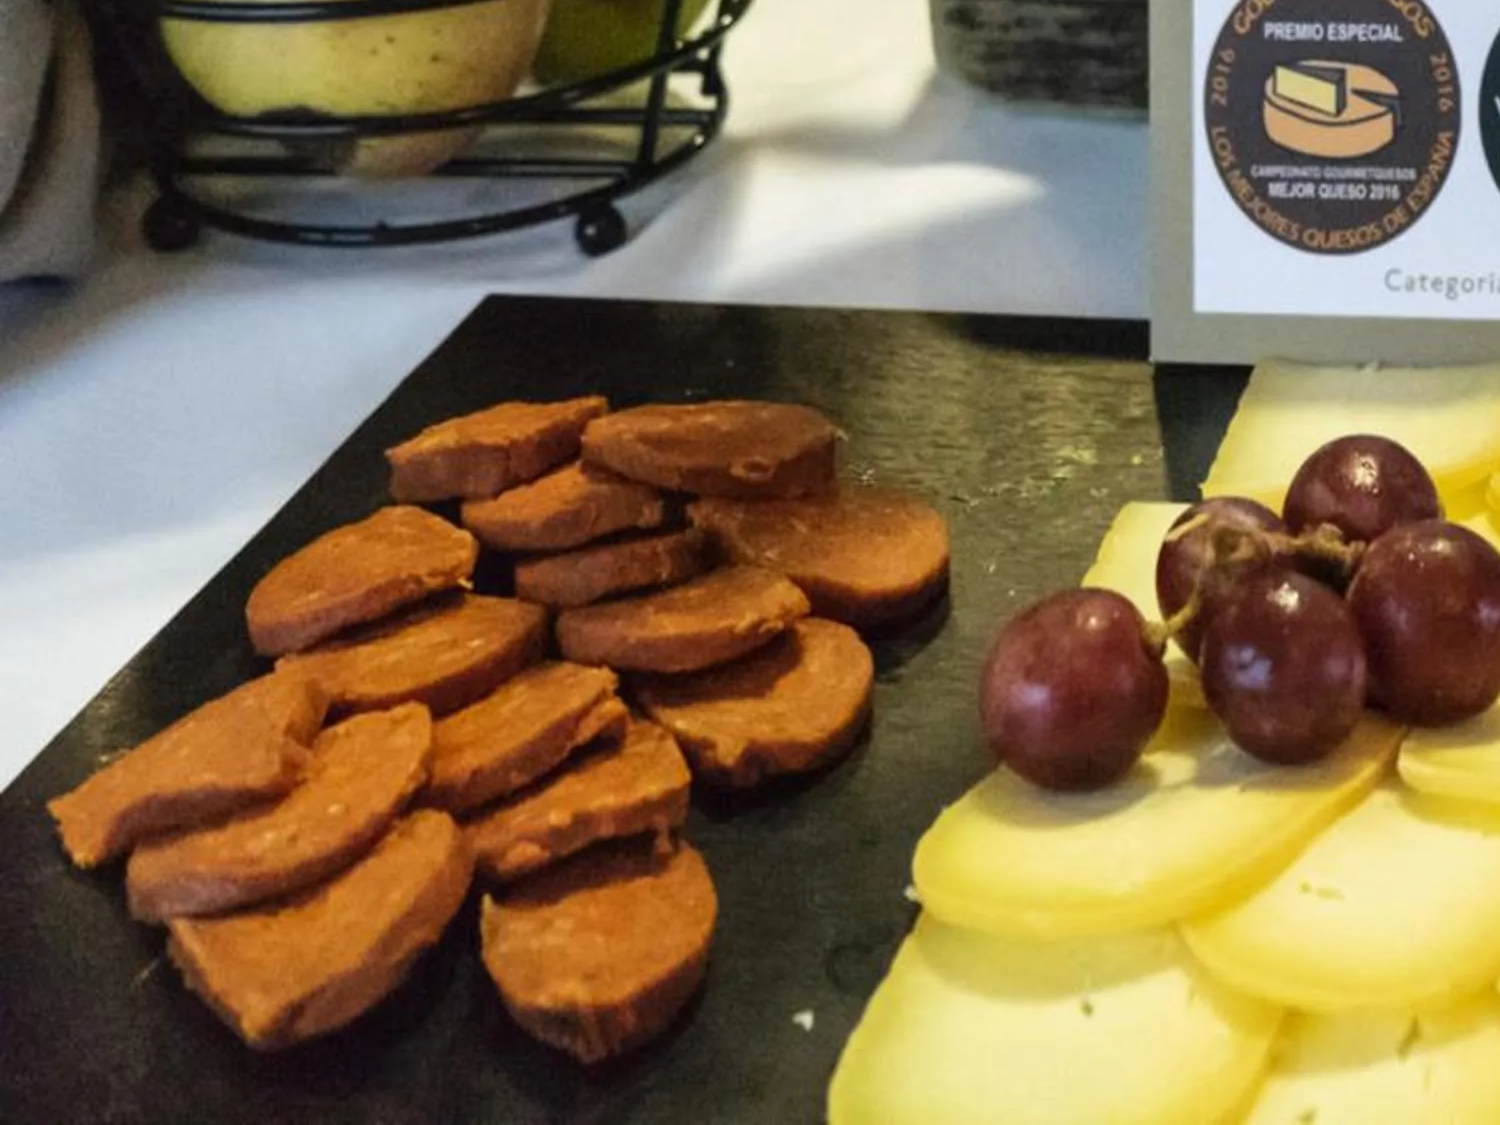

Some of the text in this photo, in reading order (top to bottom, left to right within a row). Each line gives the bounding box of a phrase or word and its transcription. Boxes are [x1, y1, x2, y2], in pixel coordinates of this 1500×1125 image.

[1264, 22, 1403, 42] PREMIO ESPECIAL
[1211, 48, 1235, 106] 2016
[1430, 52, 1454, 113] 2016
[1211, 126, 1238, 169] LOS
[1229, 169, 1299, 241] MEJORES
[1302, 223, 1383, 249] QUESOS
[1381, 209, 1408, 233] DE
[1268, 182, 1400, 201] MEJOR QUESO 2016
